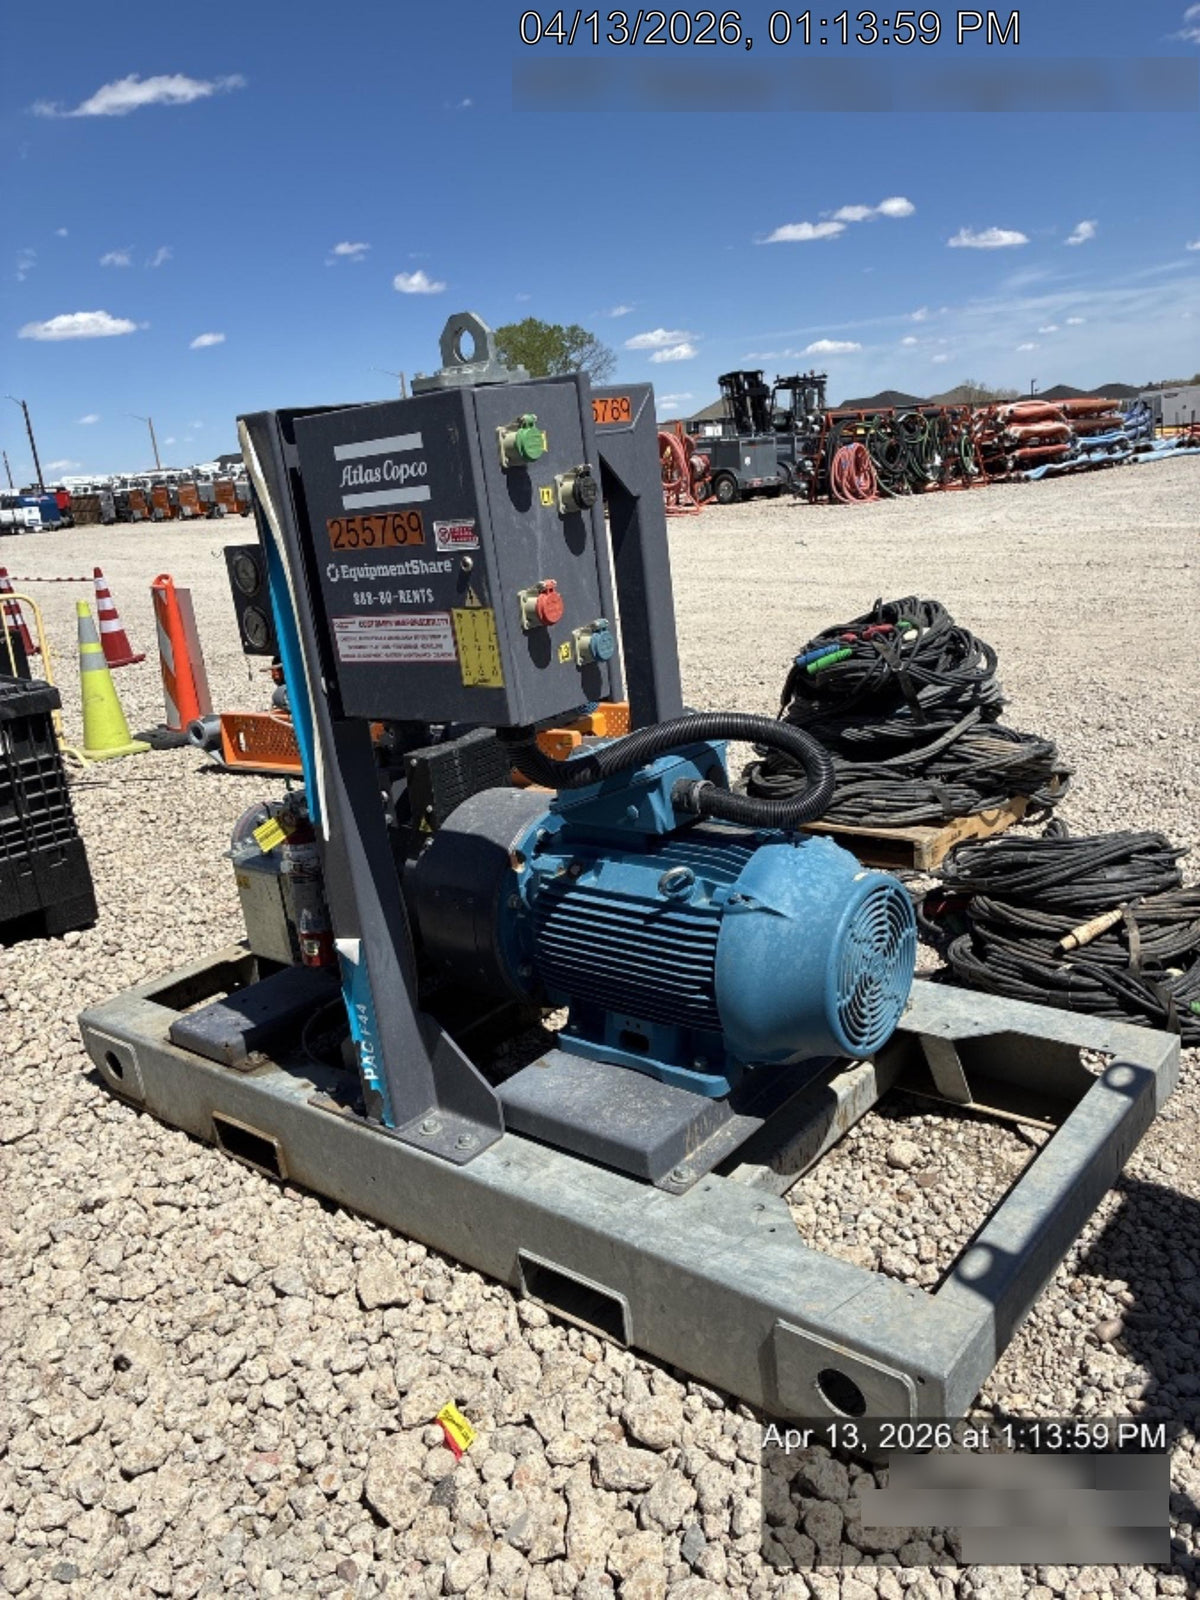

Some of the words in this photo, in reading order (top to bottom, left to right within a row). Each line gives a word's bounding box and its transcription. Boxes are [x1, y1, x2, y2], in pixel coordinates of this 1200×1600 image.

[339, 464, 381, 488] Atlas
[383, 459, 428, 484] Copco
[330, 511, 423, 548] 255769
[341, 559, 453, 582] EquipmentShare
[360, 1040, 379, 1080] PAC
